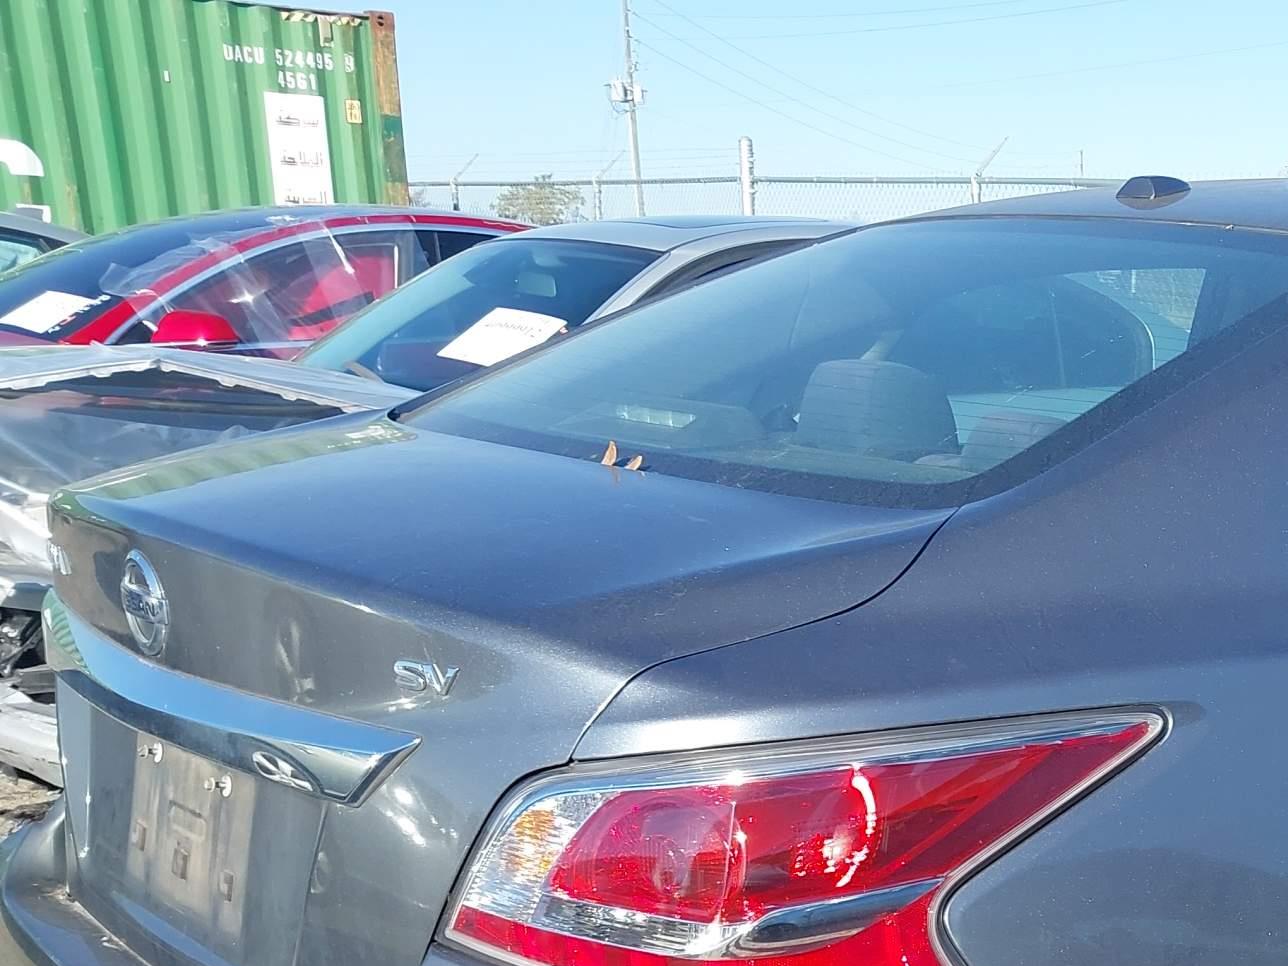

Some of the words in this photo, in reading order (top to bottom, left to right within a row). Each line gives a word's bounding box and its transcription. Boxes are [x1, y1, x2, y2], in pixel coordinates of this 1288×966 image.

[275, 48, 334, 71] 524495
[278, 70, 316, 90] 4561
[394, 659, 461, 696] SV
